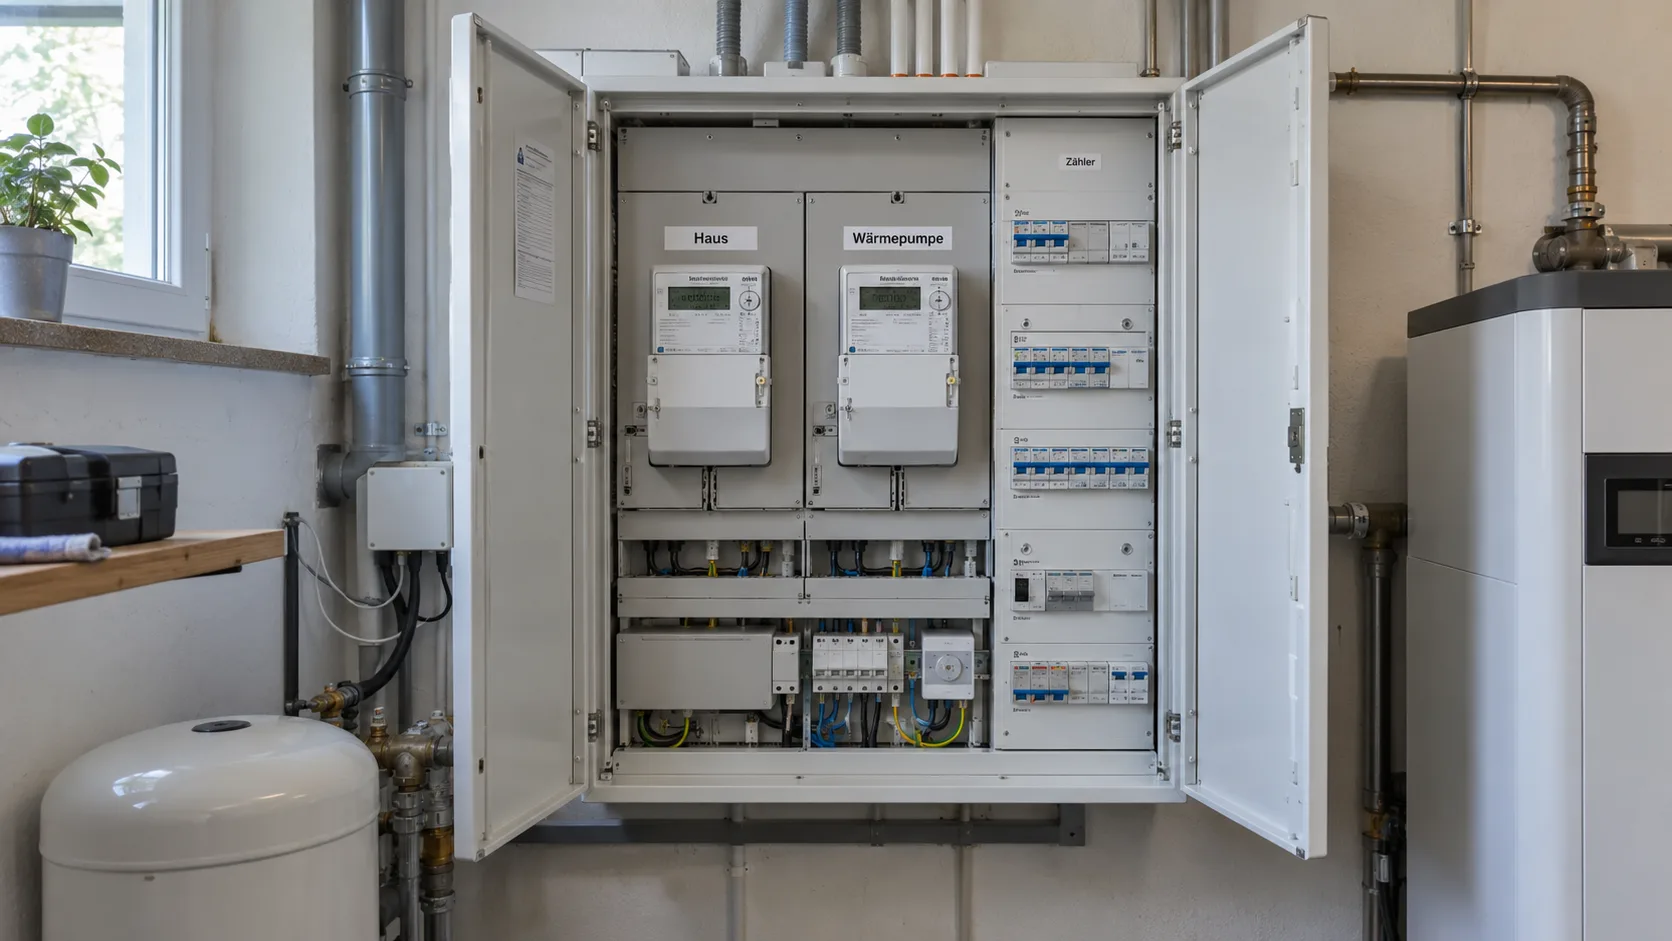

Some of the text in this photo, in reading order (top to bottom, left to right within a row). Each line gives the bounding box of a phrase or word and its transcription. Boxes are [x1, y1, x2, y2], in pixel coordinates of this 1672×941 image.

[1065, 157, 1096, 166] Zähler
[694, 232, 729, 244] Haus
[852, 232, 944, 247] Wärmepumpe
